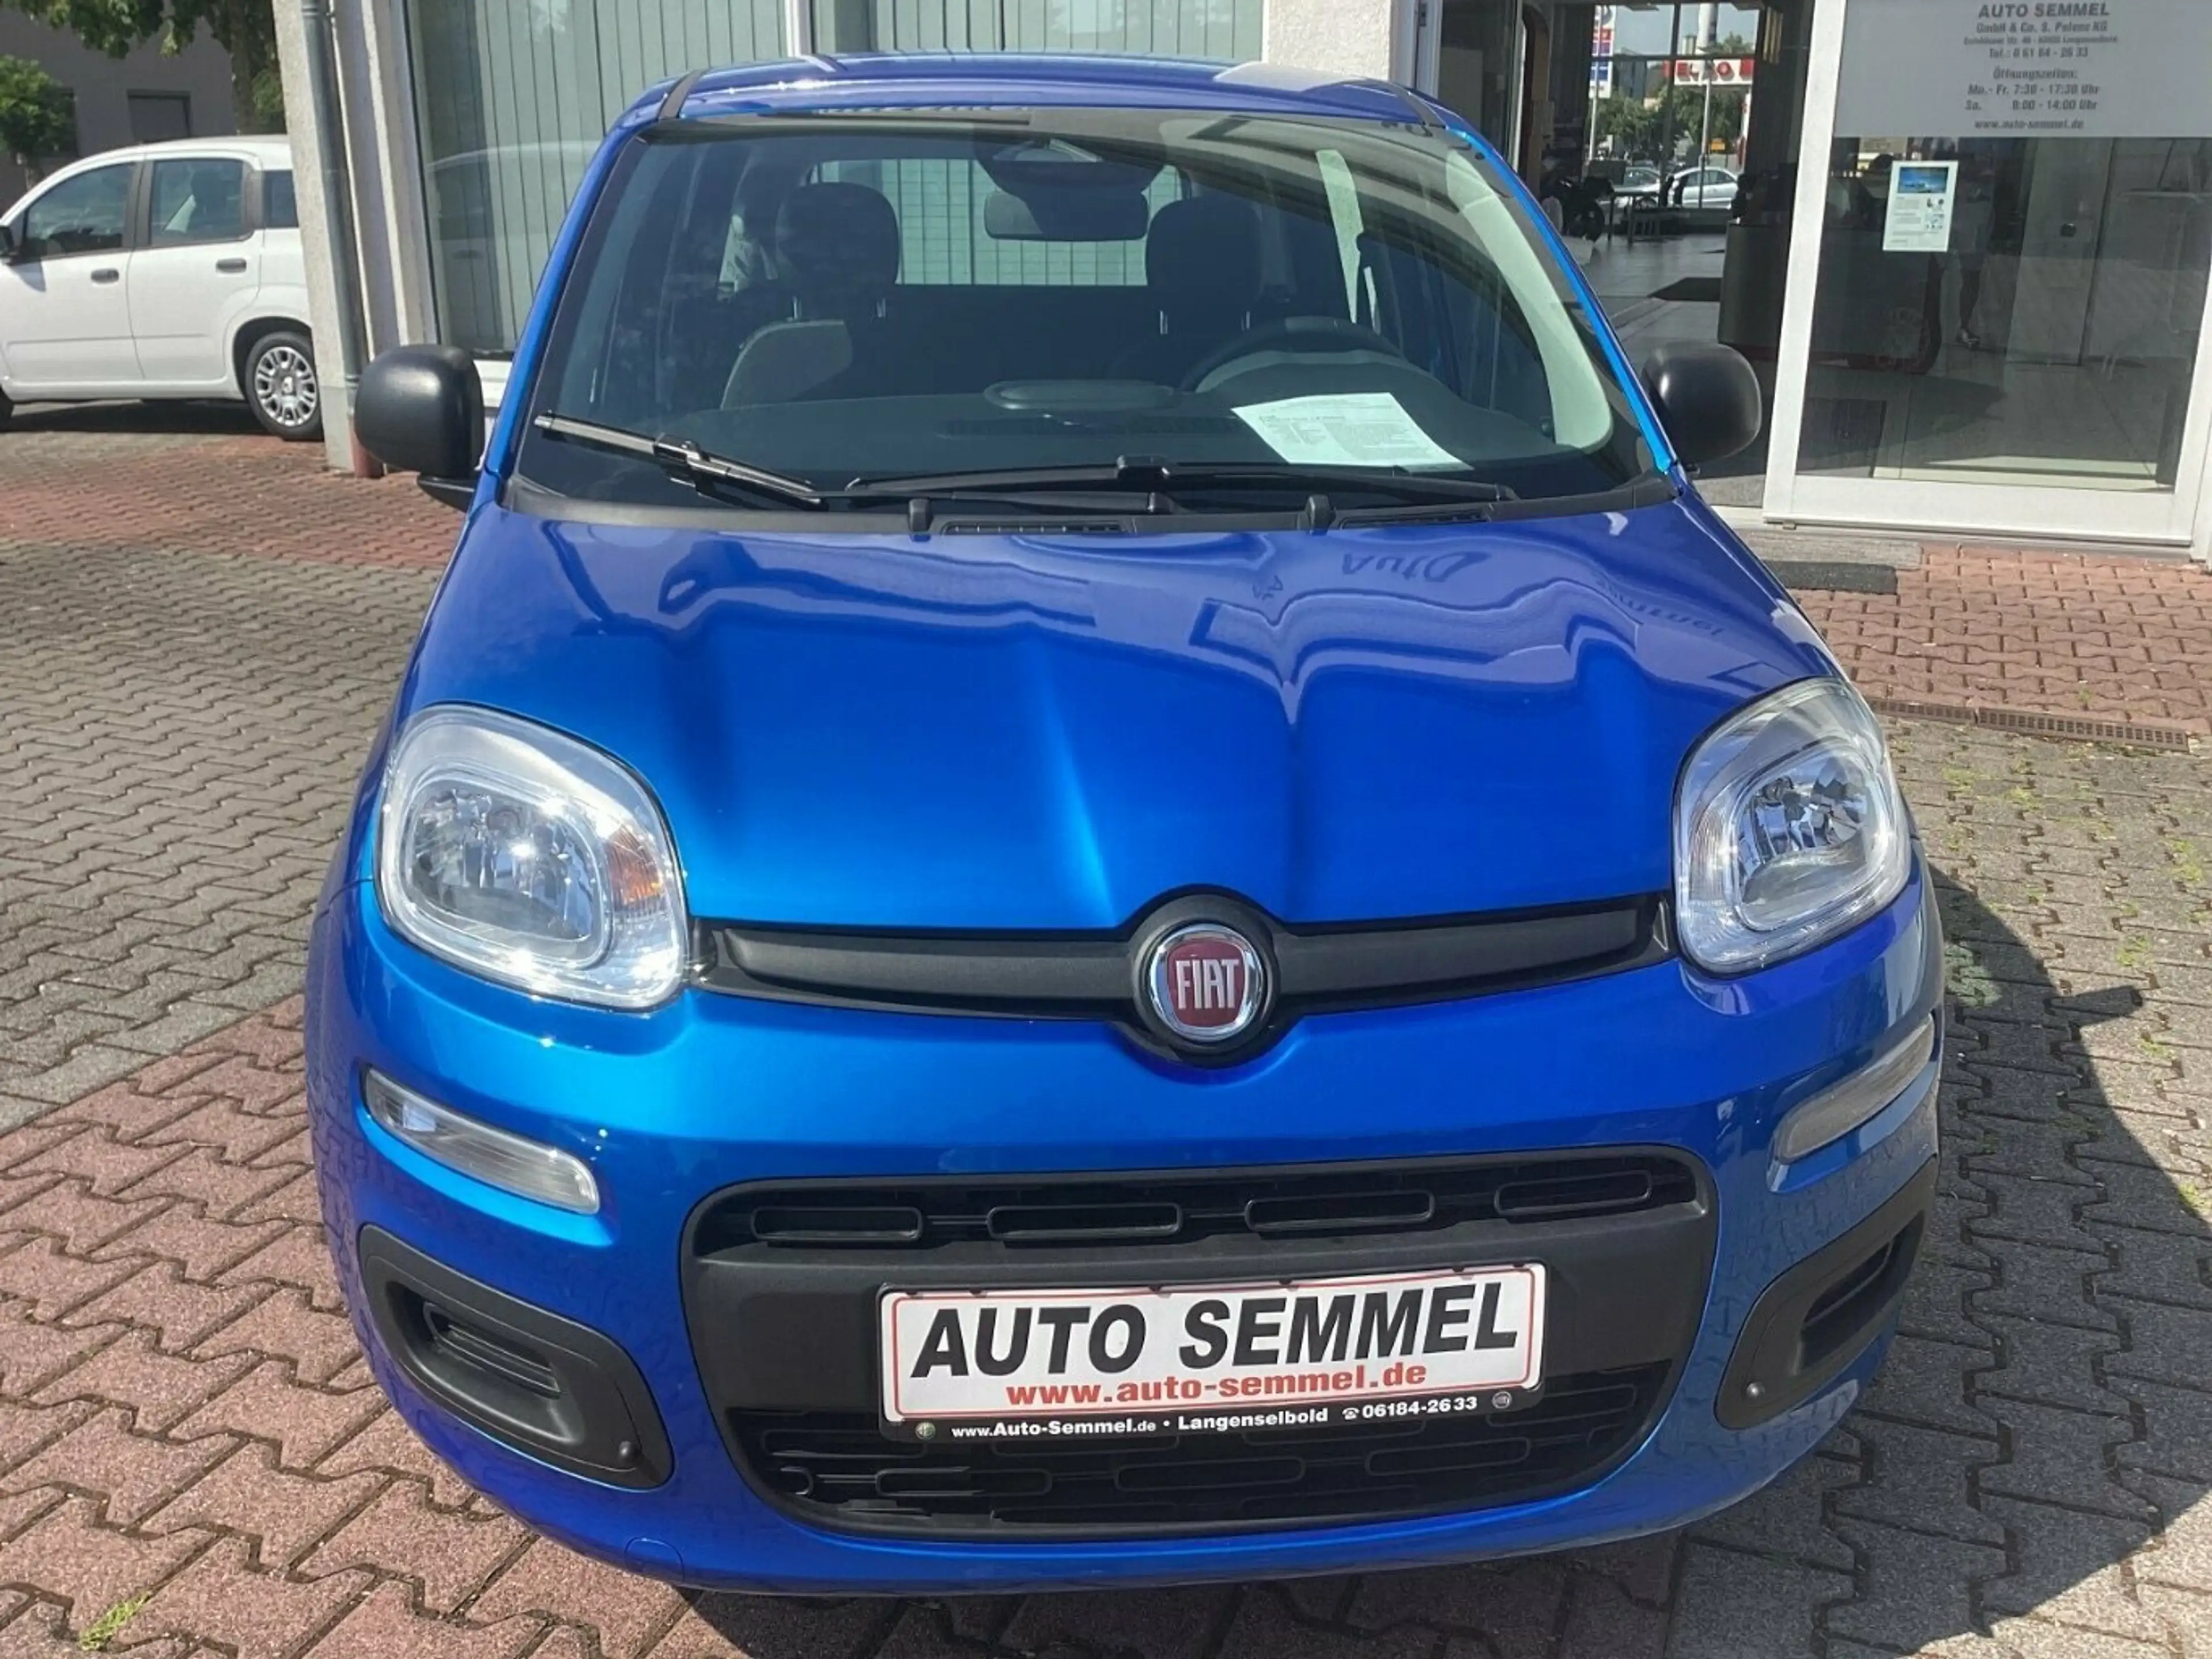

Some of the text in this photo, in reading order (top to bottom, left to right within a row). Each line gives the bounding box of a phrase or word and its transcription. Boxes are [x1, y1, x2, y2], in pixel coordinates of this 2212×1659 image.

[1978, 2, 2110, 18] AUTO SEMMEL
[1976, 22, 2005, 33] GmbH
[2009, 22, 2017, 33] &
[2014, 84, 2037, 95] 7:30
[2049, 84, 2078, 94] 17:30
[2081, 84, 2099, 94] Uhr
[1965, 100, 1982, 110] Sa.
[2048, 99, 2076, 109] 14:00
[2079, 99, 2097, 109] Uhr
[1975, 119, 2084, 129] www.auto-semmel.de
[1176, 959, 1239, 1010] FIAT
[910, 1282, 1518, 1378] AUTO SEMMEL
[1005, 1363, 1427, 1405] www.auto-semmel.de
[951, 1418, 1156, 1437] www.Auto-Semmel.de
[1178, 1408, 1328, 1431] Langenselbold
